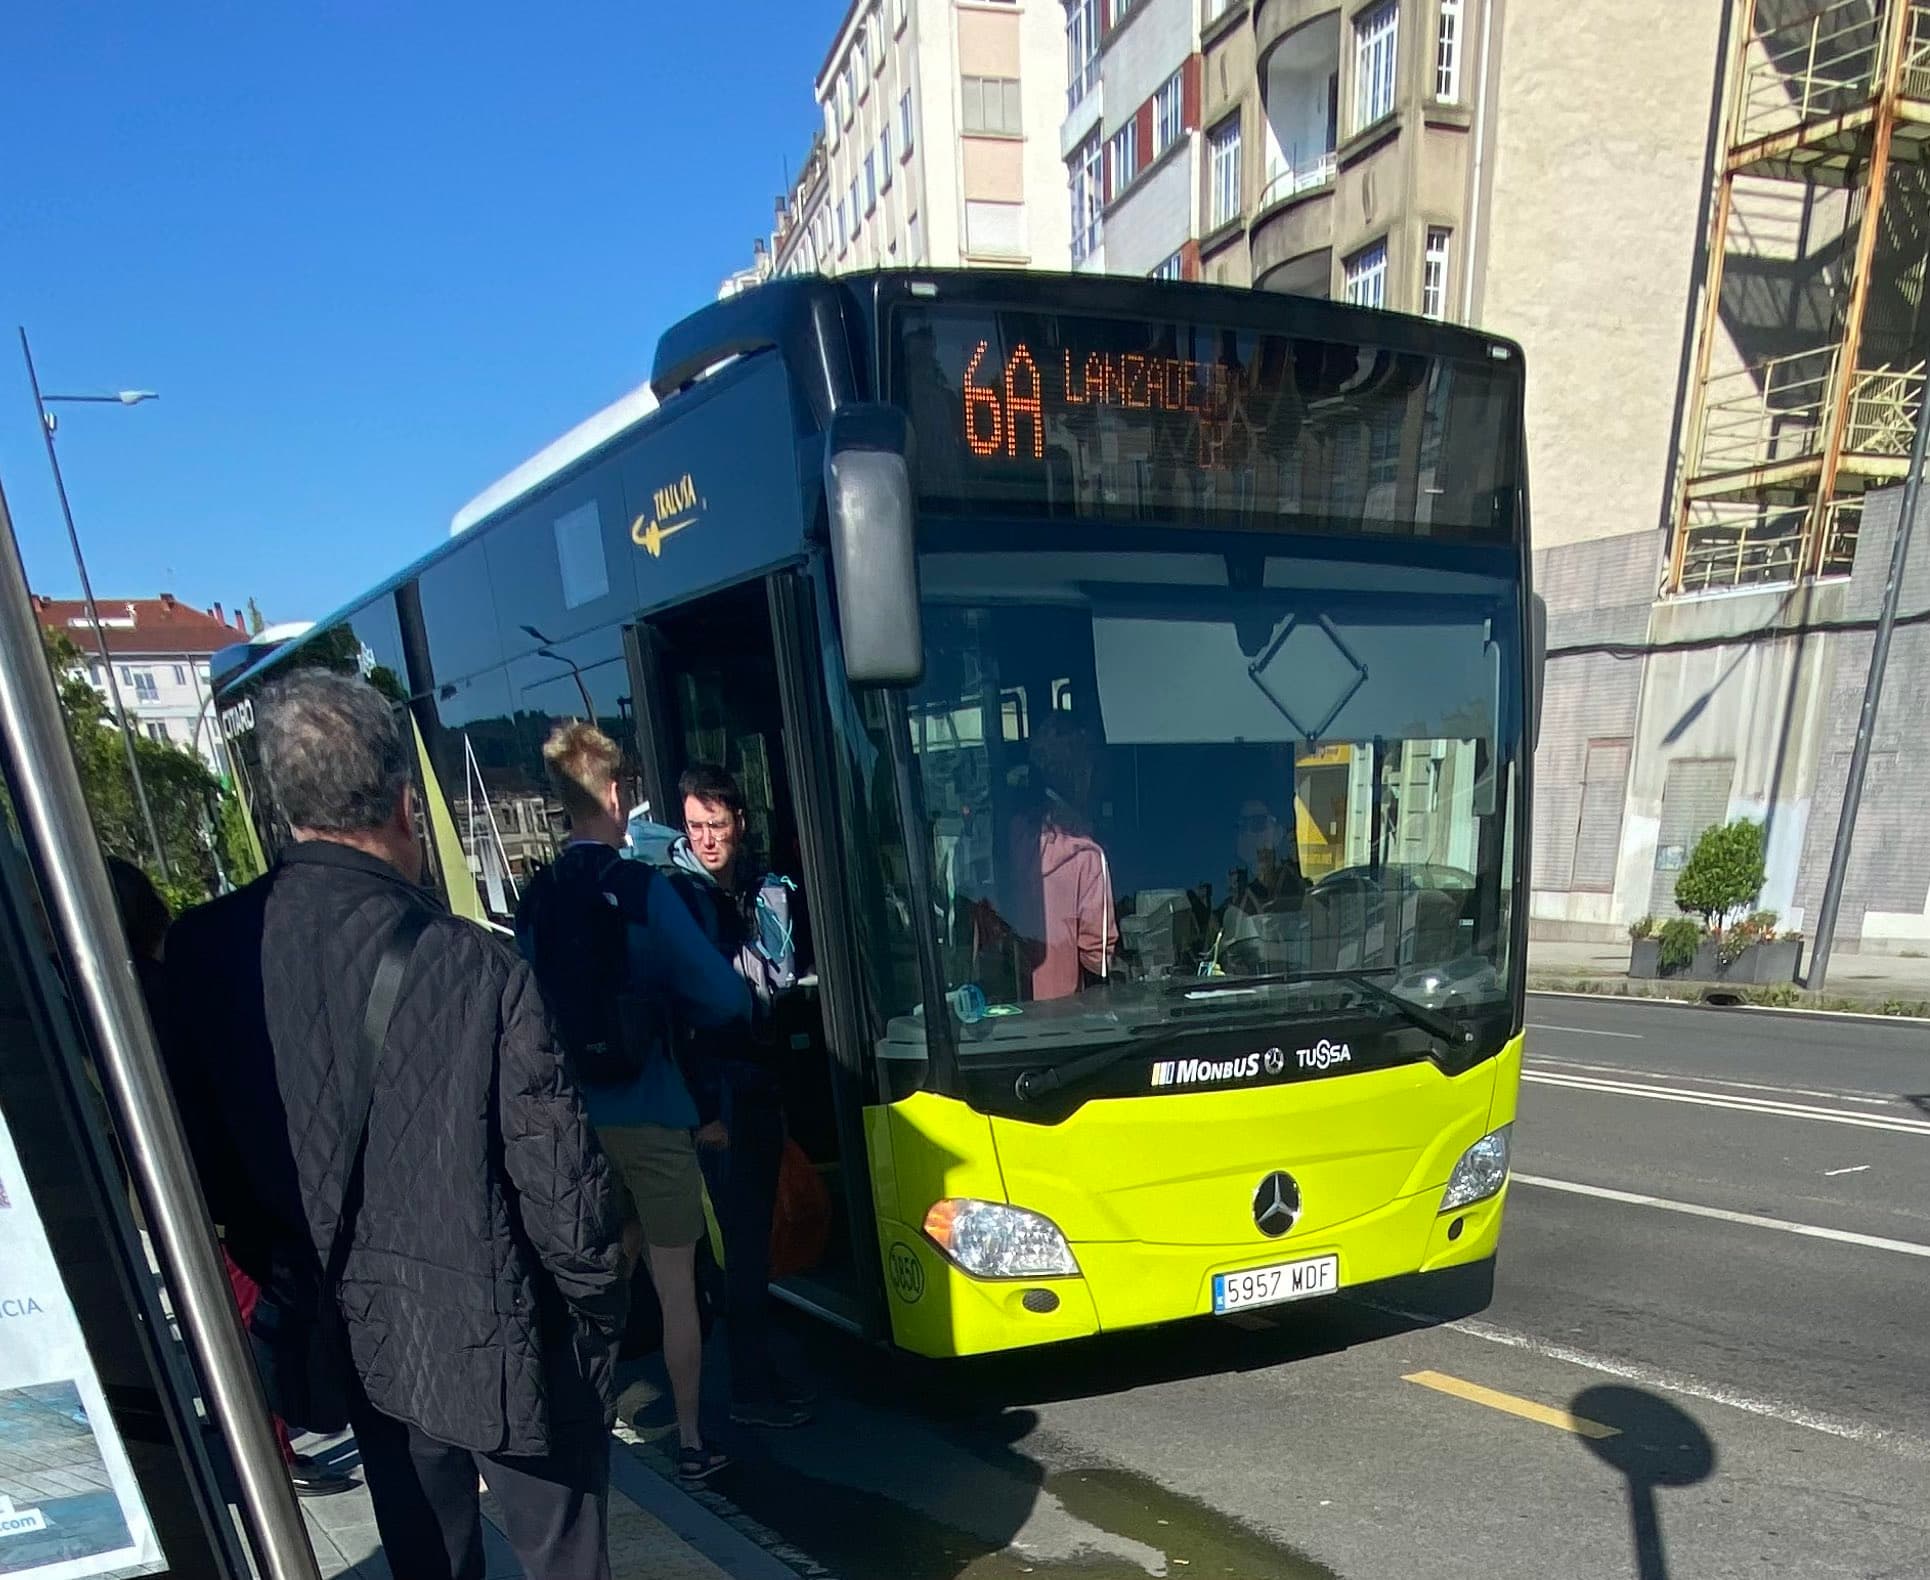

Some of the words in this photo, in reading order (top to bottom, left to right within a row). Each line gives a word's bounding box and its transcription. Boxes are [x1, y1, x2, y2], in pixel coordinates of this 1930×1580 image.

[963, 339, 1043, 459] 6A
[1296, 1039, 1351, 1070] TUSSA
[1228, 1271, 1281, 1303] 5957
[1292, 1263, 1331, 1292] MDF
